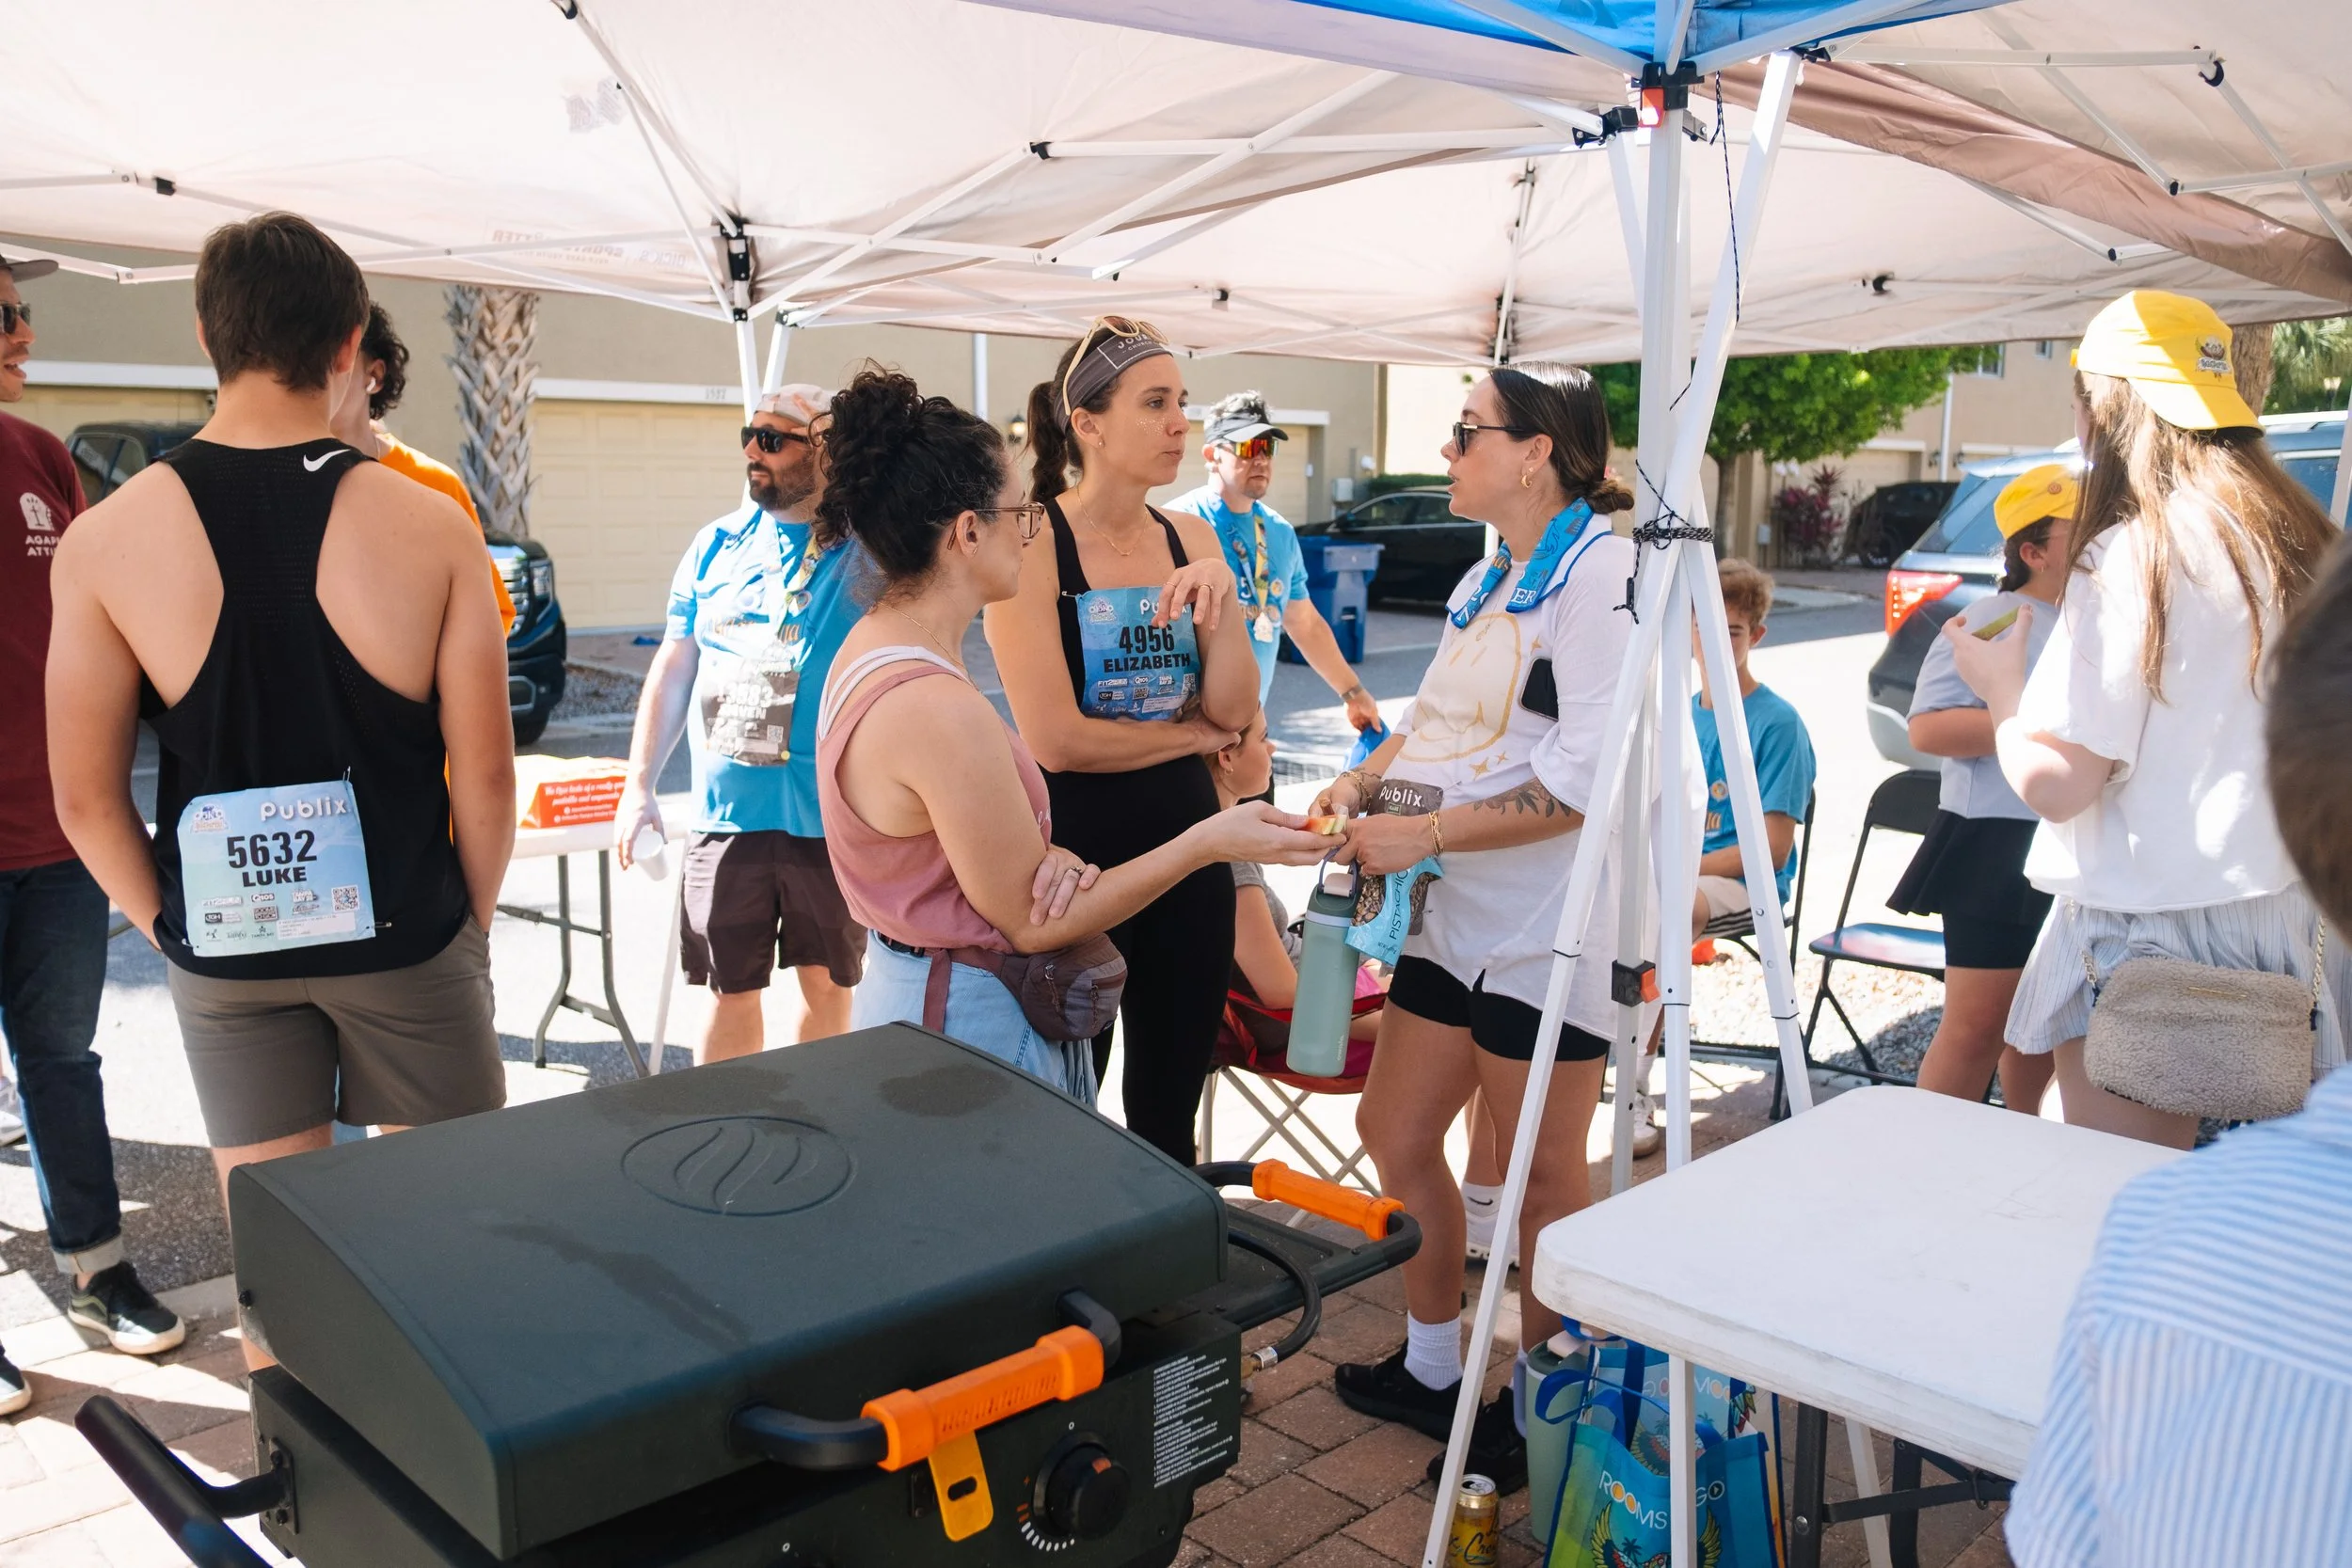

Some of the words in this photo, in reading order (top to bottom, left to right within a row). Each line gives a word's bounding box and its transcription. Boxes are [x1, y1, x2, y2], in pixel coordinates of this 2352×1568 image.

[1118, 333, 1149, 349] JOUR
[27, 546, 56, 557] ATTI
[1119, 623, 1175, 655] 4956
[1103, 652, 1191, 673] ELIZABETH
[1379, 785, 1424, 808] Publix
[260, 797, 347, 821] Publix
[227, 830, 318, 869] 5632
[242, 866, 308, 888] LUKE
[1389, 869, 1409, 941] PISTACHIO
[1598, 1469, 1668, 1529] ROOMS
